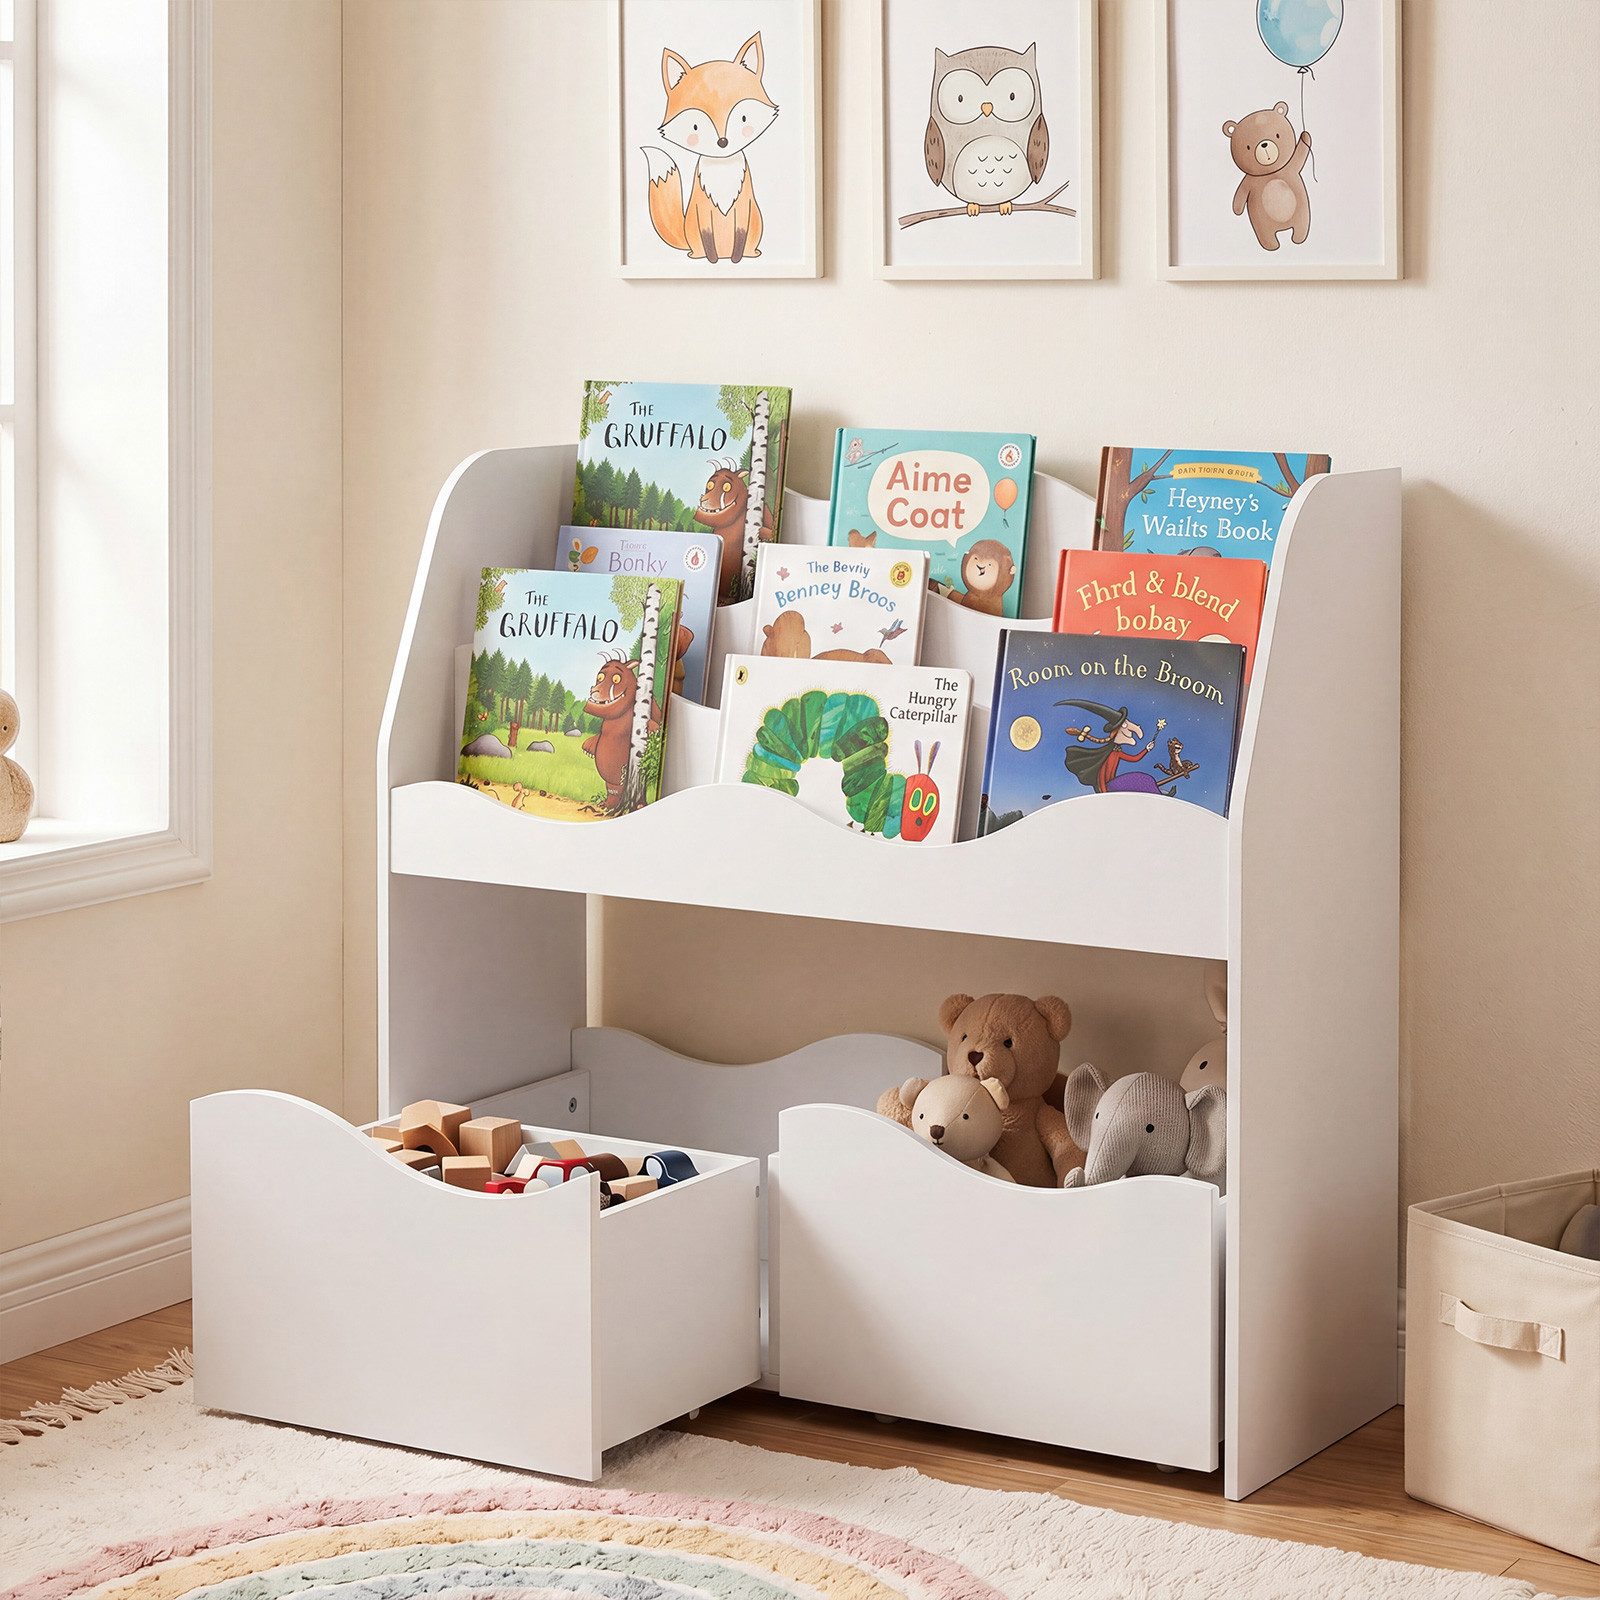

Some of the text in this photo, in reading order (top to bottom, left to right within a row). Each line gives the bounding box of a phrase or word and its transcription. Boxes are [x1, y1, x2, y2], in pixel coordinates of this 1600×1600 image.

[629, 401, 654, 416] THE
[604, 421, 727, 451] GRUFFALO
[886, 460, 972, 494] Aime
[886, 497, 966, 529] Coat
[1167, 487, 1259, 516] Heyney's
[1141, 514, 1274, 542] Wailts Book
[608, 551, 668, 577] Bonky
[806, 561, 830, 574] The
[525, 590, 549, 606] THE
[774, 579, 897, 613] Benney Broos
[1076, 570, 1241, 623] Fhrd & blend
[499, 611, 619, 644] GRUFFALO
[1115, 604, 1192, 640] bobay
[934, 677, 959, 692] The
[1008, 654, 1224, 706] Room on the Broom
[889, 706, 958, 725] Caterpillar
[908, 691, 957, 711] Hungry
